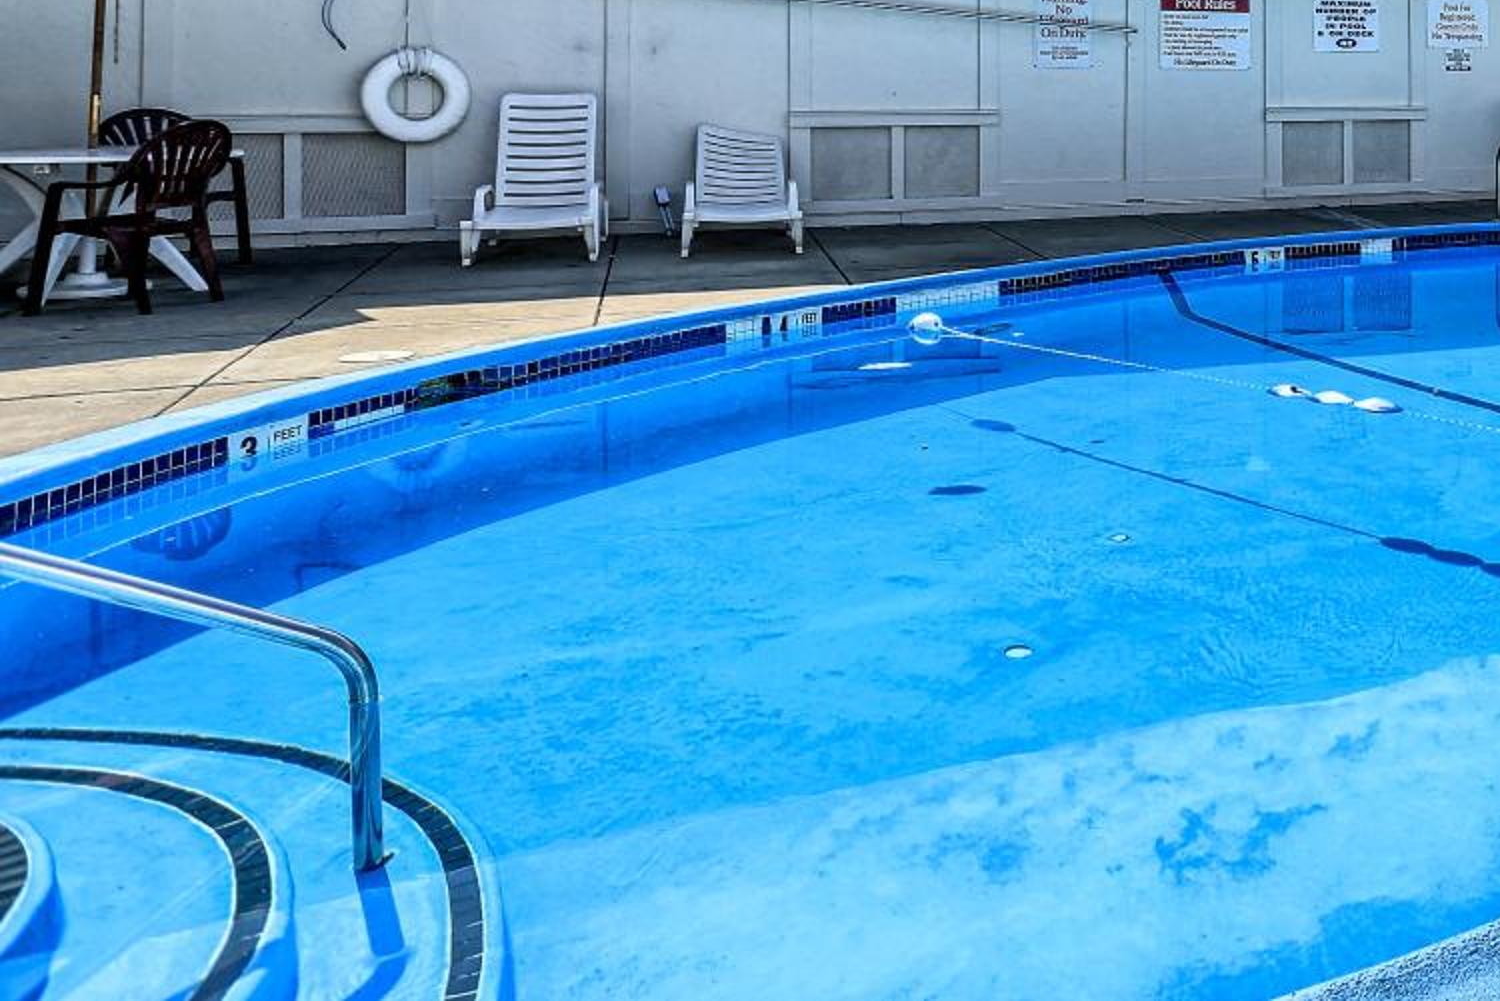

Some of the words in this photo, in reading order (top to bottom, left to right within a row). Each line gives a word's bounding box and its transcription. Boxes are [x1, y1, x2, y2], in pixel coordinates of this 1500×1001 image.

[1056, 5, 1073, 16] No
[240, 435, 258, 458] 3
[273, 424, 303, 443] FEET
